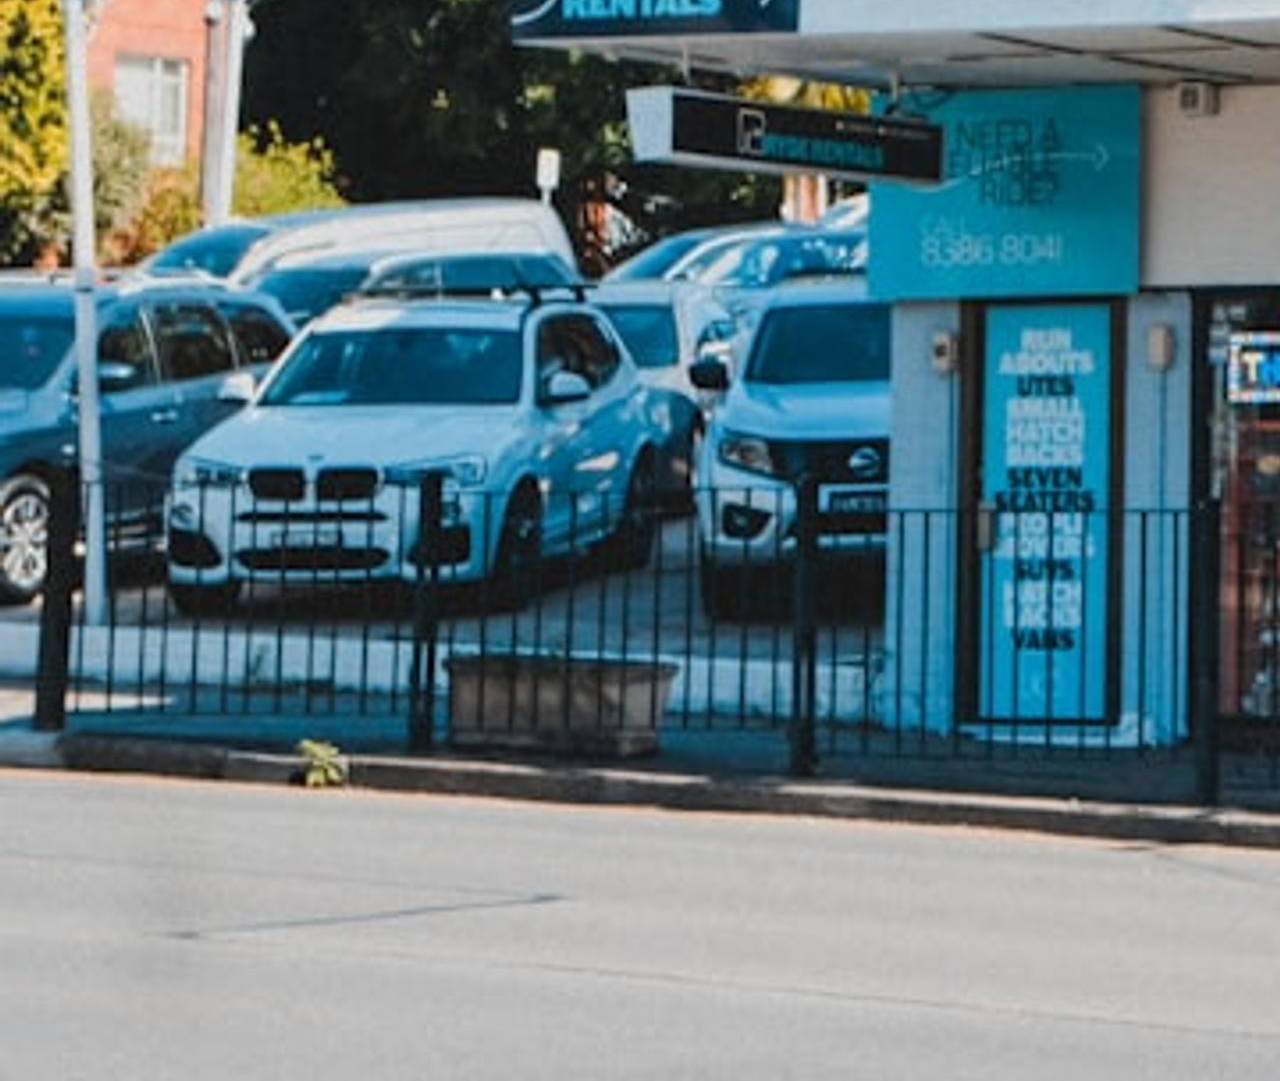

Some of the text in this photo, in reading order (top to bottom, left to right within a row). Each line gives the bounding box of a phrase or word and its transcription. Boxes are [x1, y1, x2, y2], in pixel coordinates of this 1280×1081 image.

[999, 350, 1095, 374] ABOUTS
[1017, 373, 1075, 396] UTES
[1007, 467, 1083, 489] SEVEN
[996, 490, 1094, 512] SEATERS
